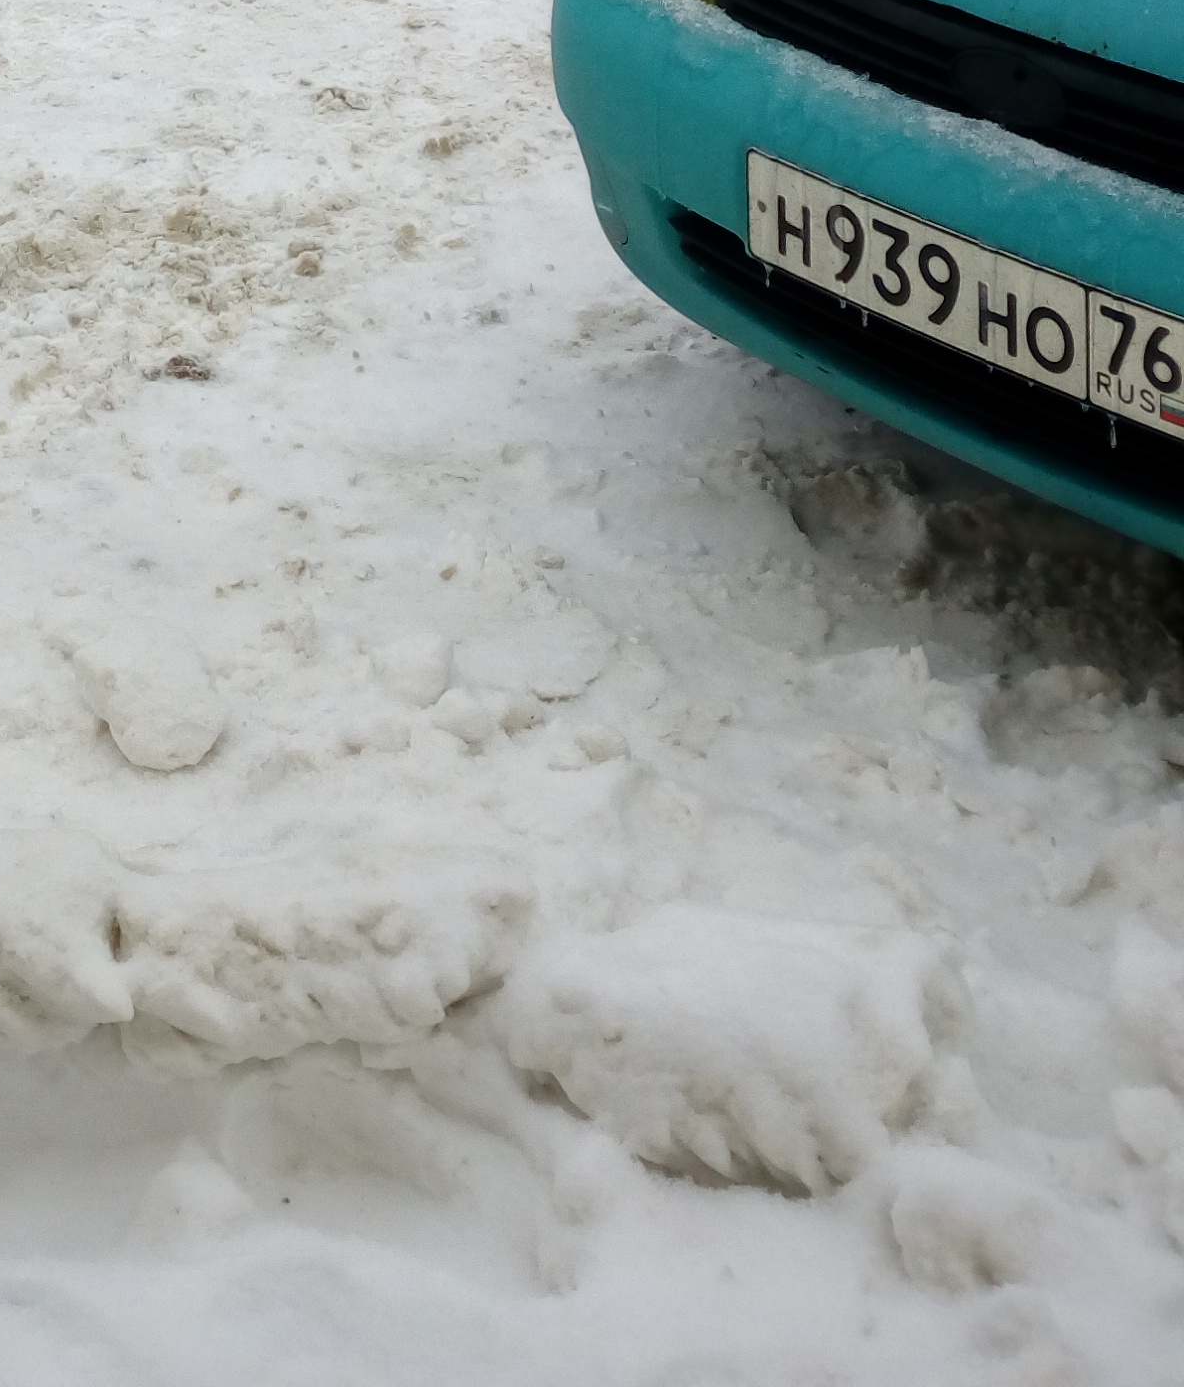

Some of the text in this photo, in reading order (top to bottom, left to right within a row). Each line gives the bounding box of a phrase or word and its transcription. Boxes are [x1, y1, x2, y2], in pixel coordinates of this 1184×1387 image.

[777, 195, 1183, 394] Н939НО 76
[1096, 372, 1156, 414] RUS
